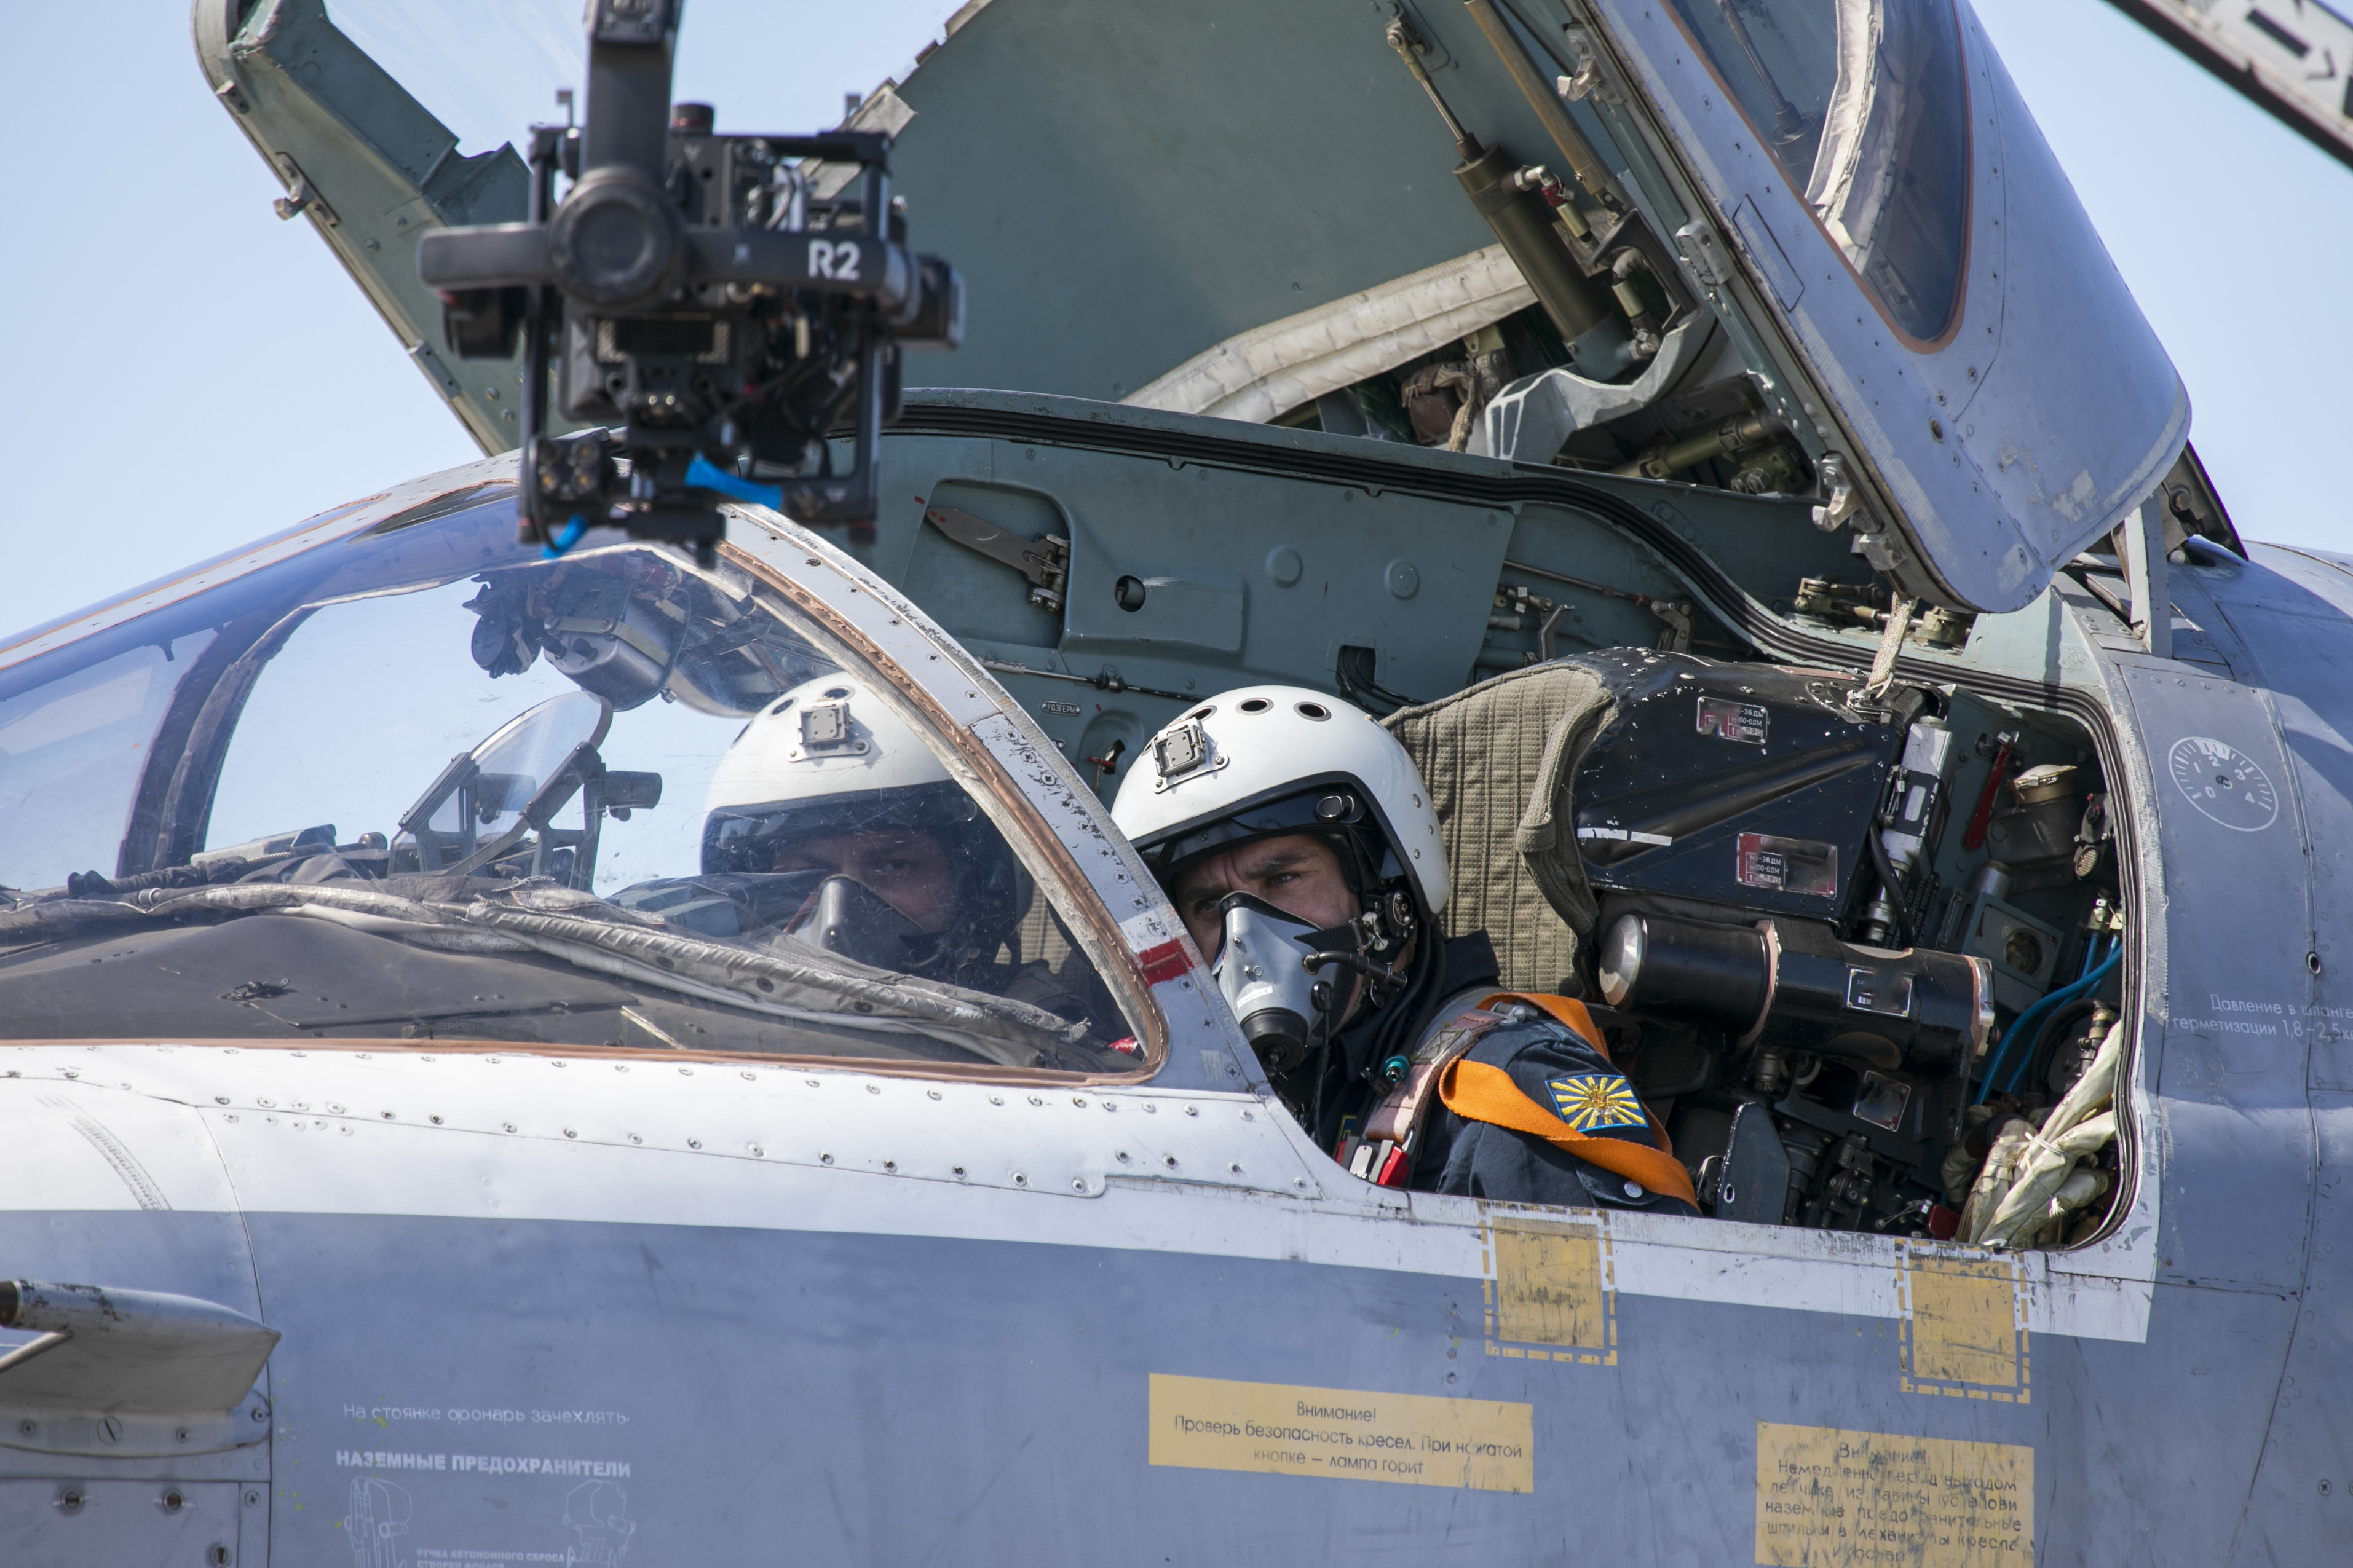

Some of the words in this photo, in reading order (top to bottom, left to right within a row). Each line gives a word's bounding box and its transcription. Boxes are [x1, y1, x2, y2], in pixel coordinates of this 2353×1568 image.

[808, 238, 860, 281] R2
[2209, 755, 2221, 767] 2
[2234, 769, 2246, 780] 3
[2244, 792, 2255, 803] 4
[2210, 993, 2282, 1014] Давление
[2288, 1004, 2296, 1015] в
[2173, 1018, 2277, 1036] герметизации
[343, 1403, 366, 1419] На
[371, 1406, 441, 1420] стоянке
[448, 1408, 525, 1425] фонарь
[1297, 1401, 1377, 1423] Внимание!
[1174, 1416, 1241, 1436] Проверь
[1244, 1419, 1353, 1445] безопасность
[1422, 1435, 1450, 1455] При
[336, 1450, 446, 1470] НАЗЕМНЫЕ
[452, 1454, 631, 1478] ПРЕДОХРАНИТЕЛИ
[1253, 1448, 1307, 1465] кнопке
[1329, 1455, 1378, 1471] лампа
[1382, 1459, 1424, 1475] горит
